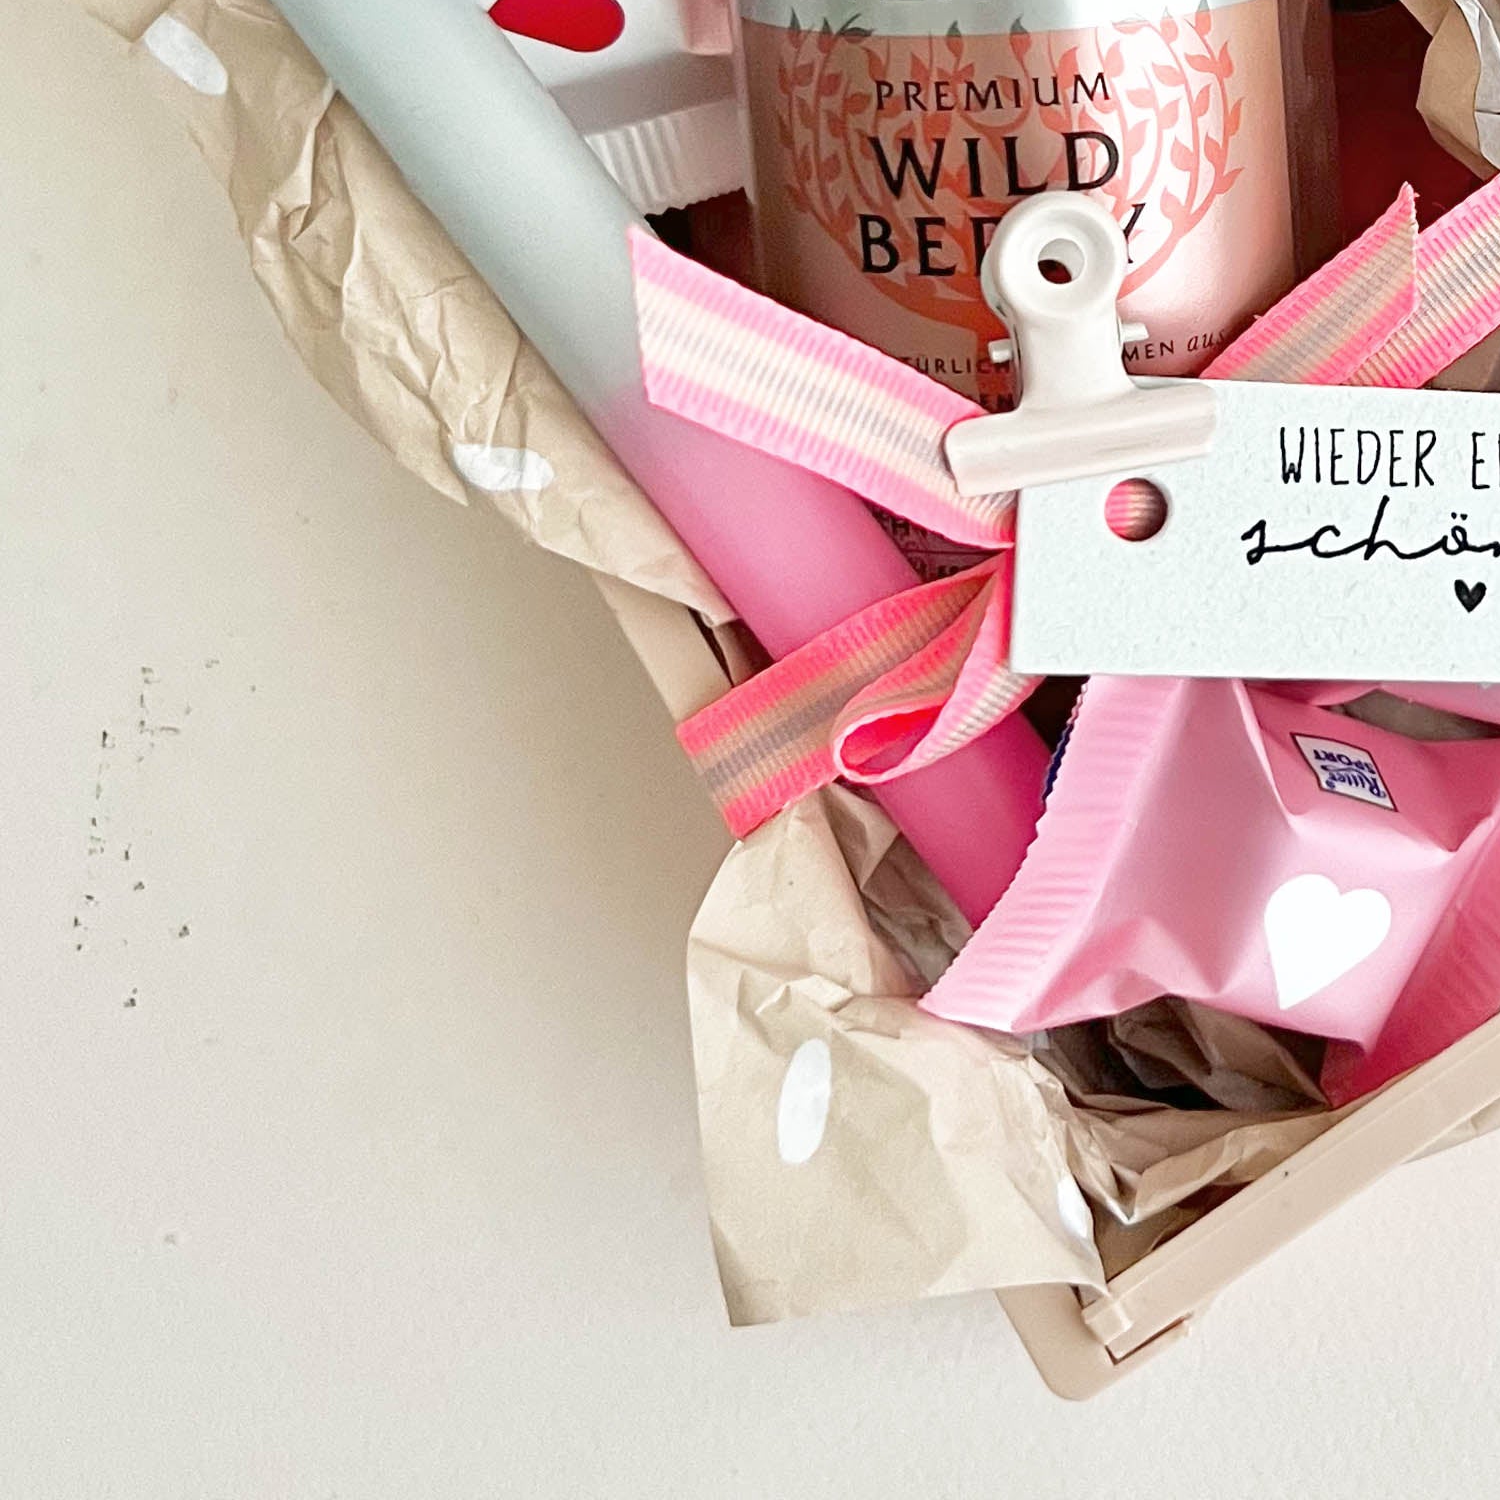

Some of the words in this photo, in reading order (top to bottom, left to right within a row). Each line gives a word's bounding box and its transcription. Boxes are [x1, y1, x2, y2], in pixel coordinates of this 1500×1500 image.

[875, 71, 1111, 112] PREMIUM
[868, 130, 1119, 200] WILD
[1279, 426, 1437, 489] WIEDER
